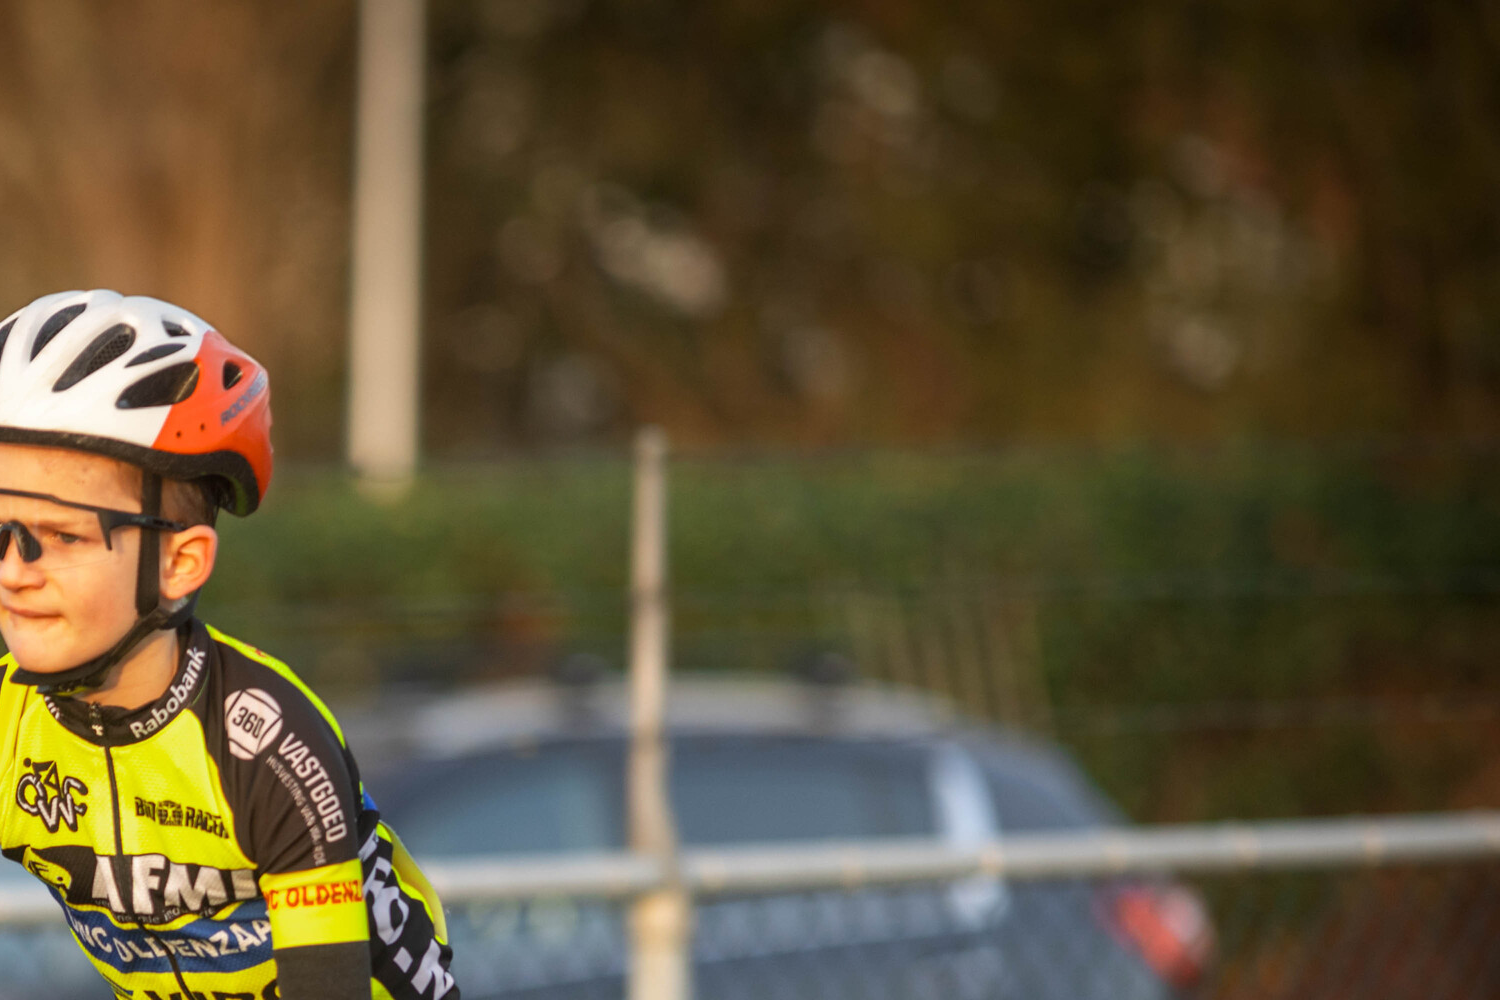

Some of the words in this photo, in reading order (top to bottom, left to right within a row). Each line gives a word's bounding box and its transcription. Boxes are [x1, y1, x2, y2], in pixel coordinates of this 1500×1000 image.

[130, 646, 206, 739] Rabobank
[232, 706, 266, 739] 360
[277, 731, 348, 844] VASTGOED
[91, 852, 259, 915] AFMI
